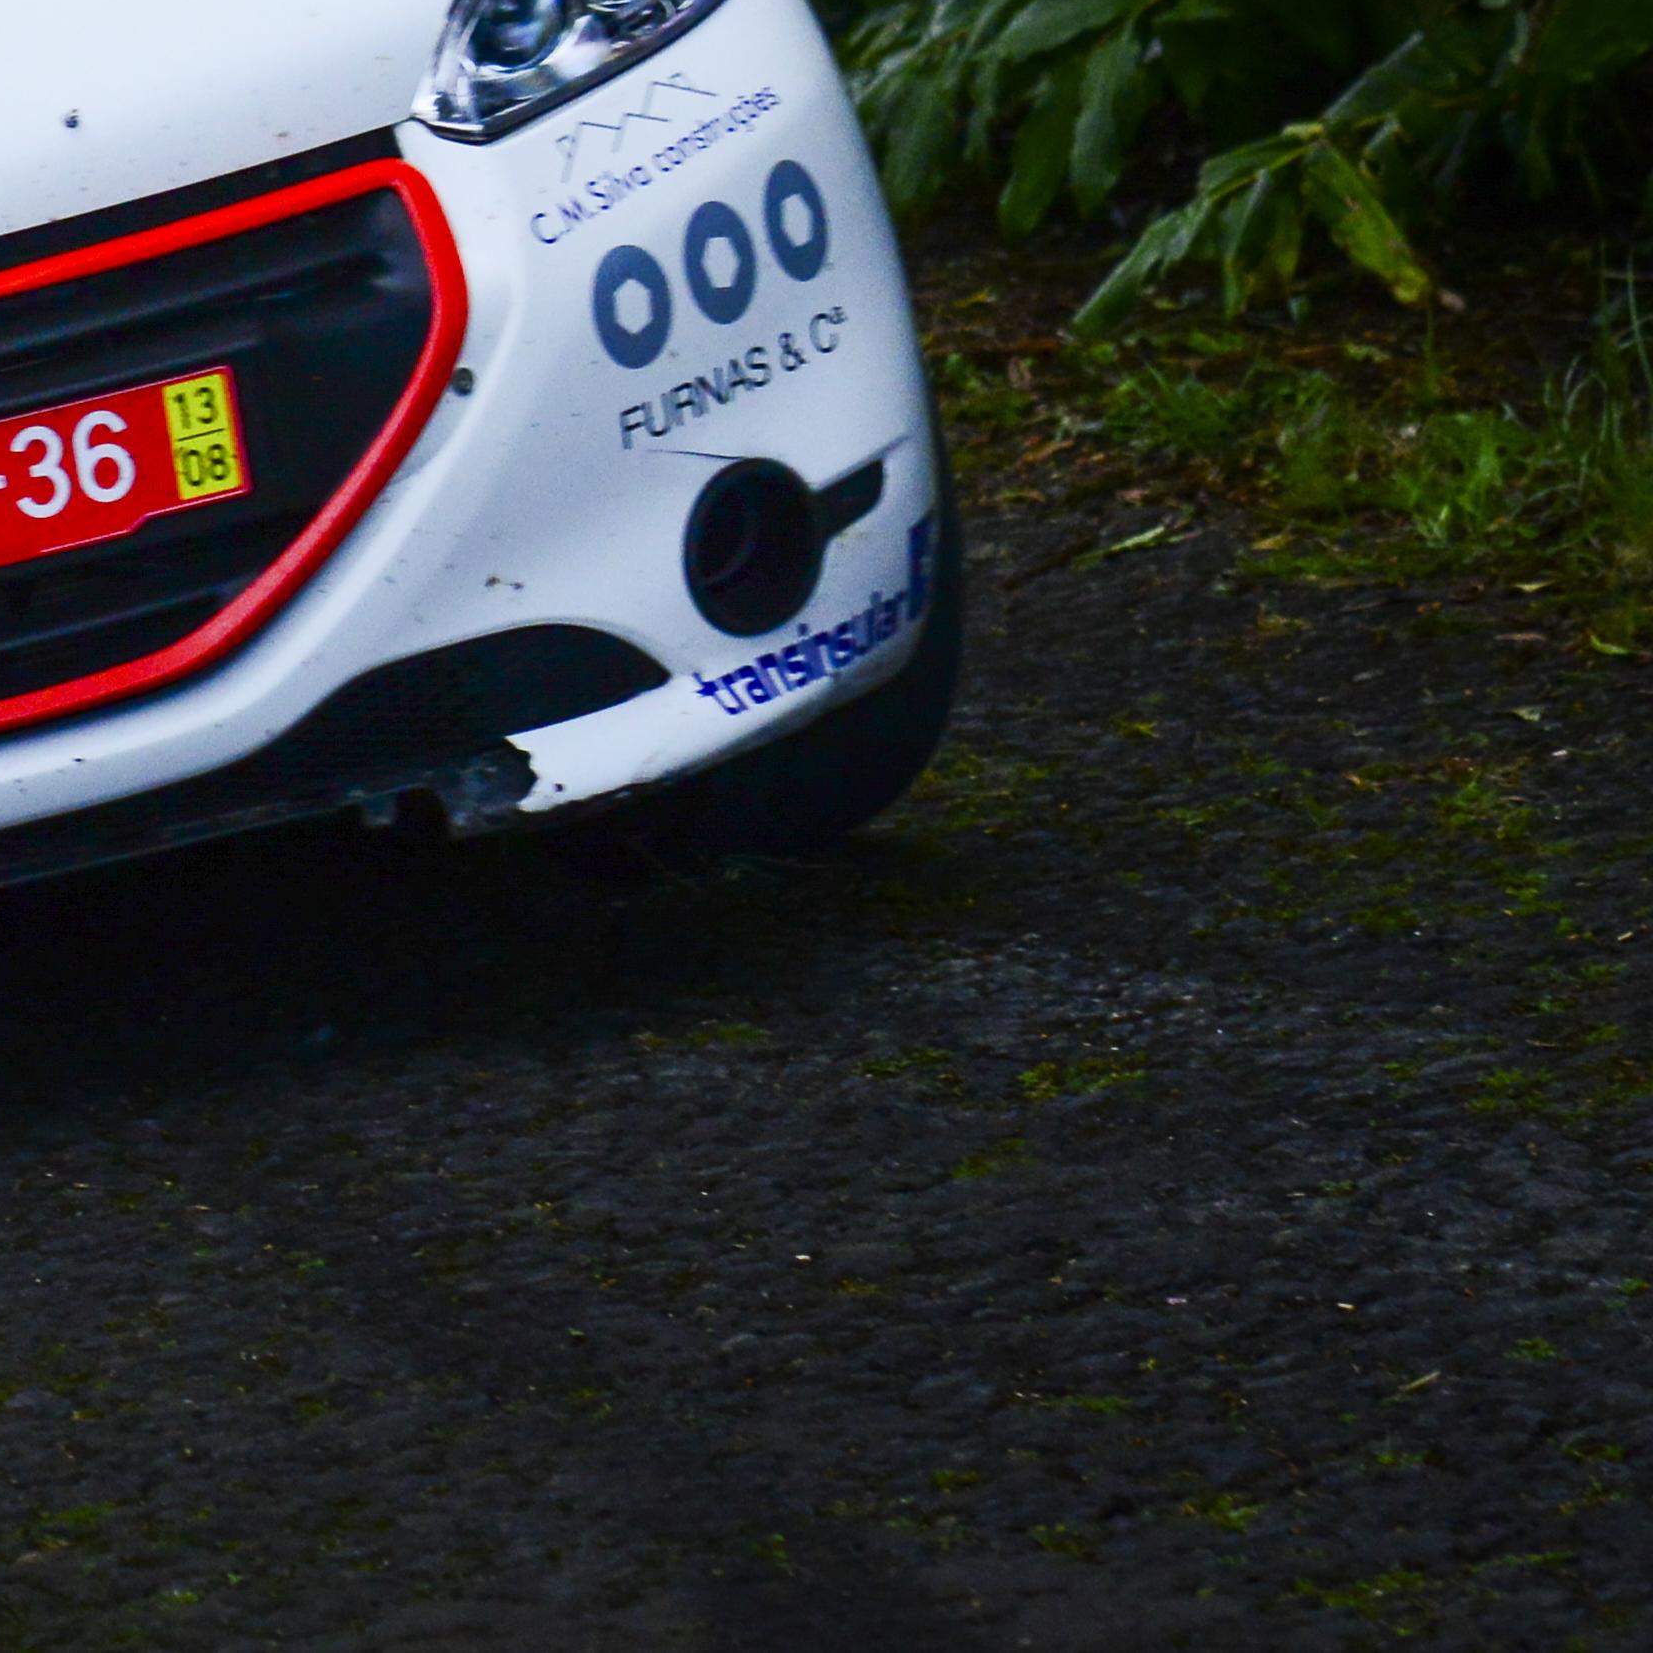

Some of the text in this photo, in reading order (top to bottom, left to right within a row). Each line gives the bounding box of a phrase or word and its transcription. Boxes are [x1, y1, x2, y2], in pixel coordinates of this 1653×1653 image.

[172, 386, 218, 430] 13
[619, 345, 773, 450] FURNAS
[777, 332, 809, 372] &
[181, 443, 231, 487] 08
